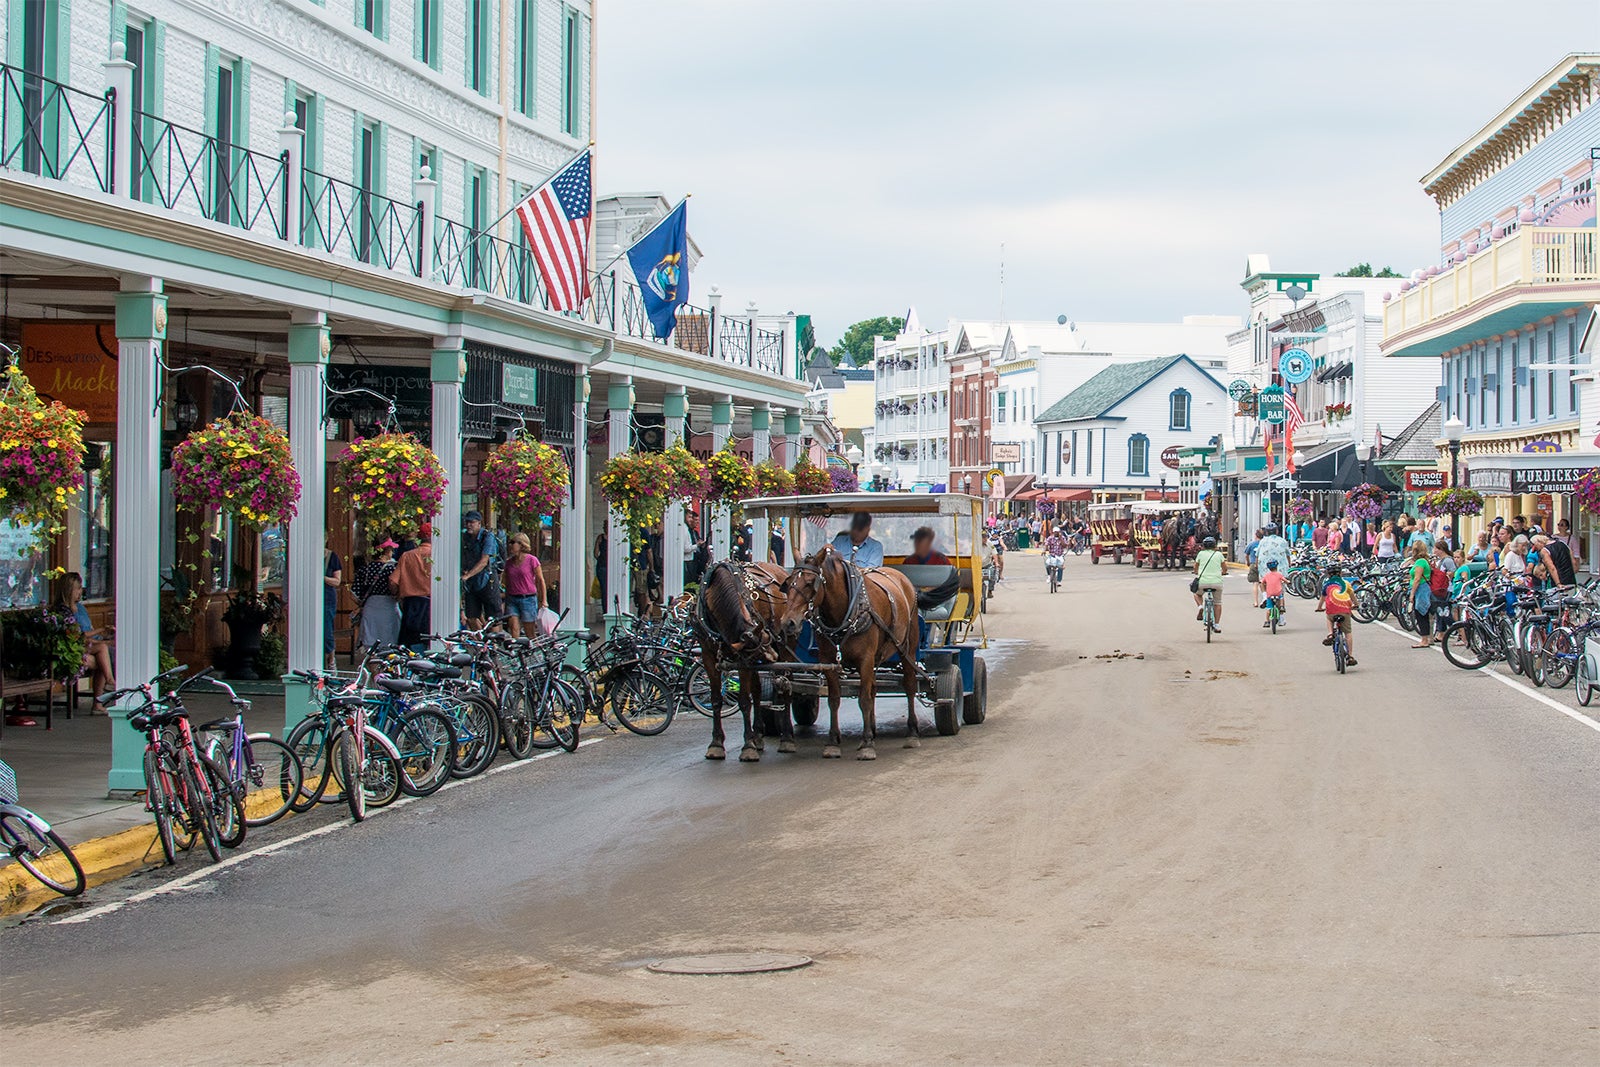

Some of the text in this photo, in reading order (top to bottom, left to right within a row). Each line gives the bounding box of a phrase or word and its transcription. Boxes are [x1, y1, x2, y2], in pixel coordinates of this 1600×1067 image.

[1261, 394, 1284, 403] HORN
[1267, 410, 1284, 420] BAR
[1516, 469, 1580, 483] MURDICKS
[1527, 483, 1575, 492] THE ORIGINAL
